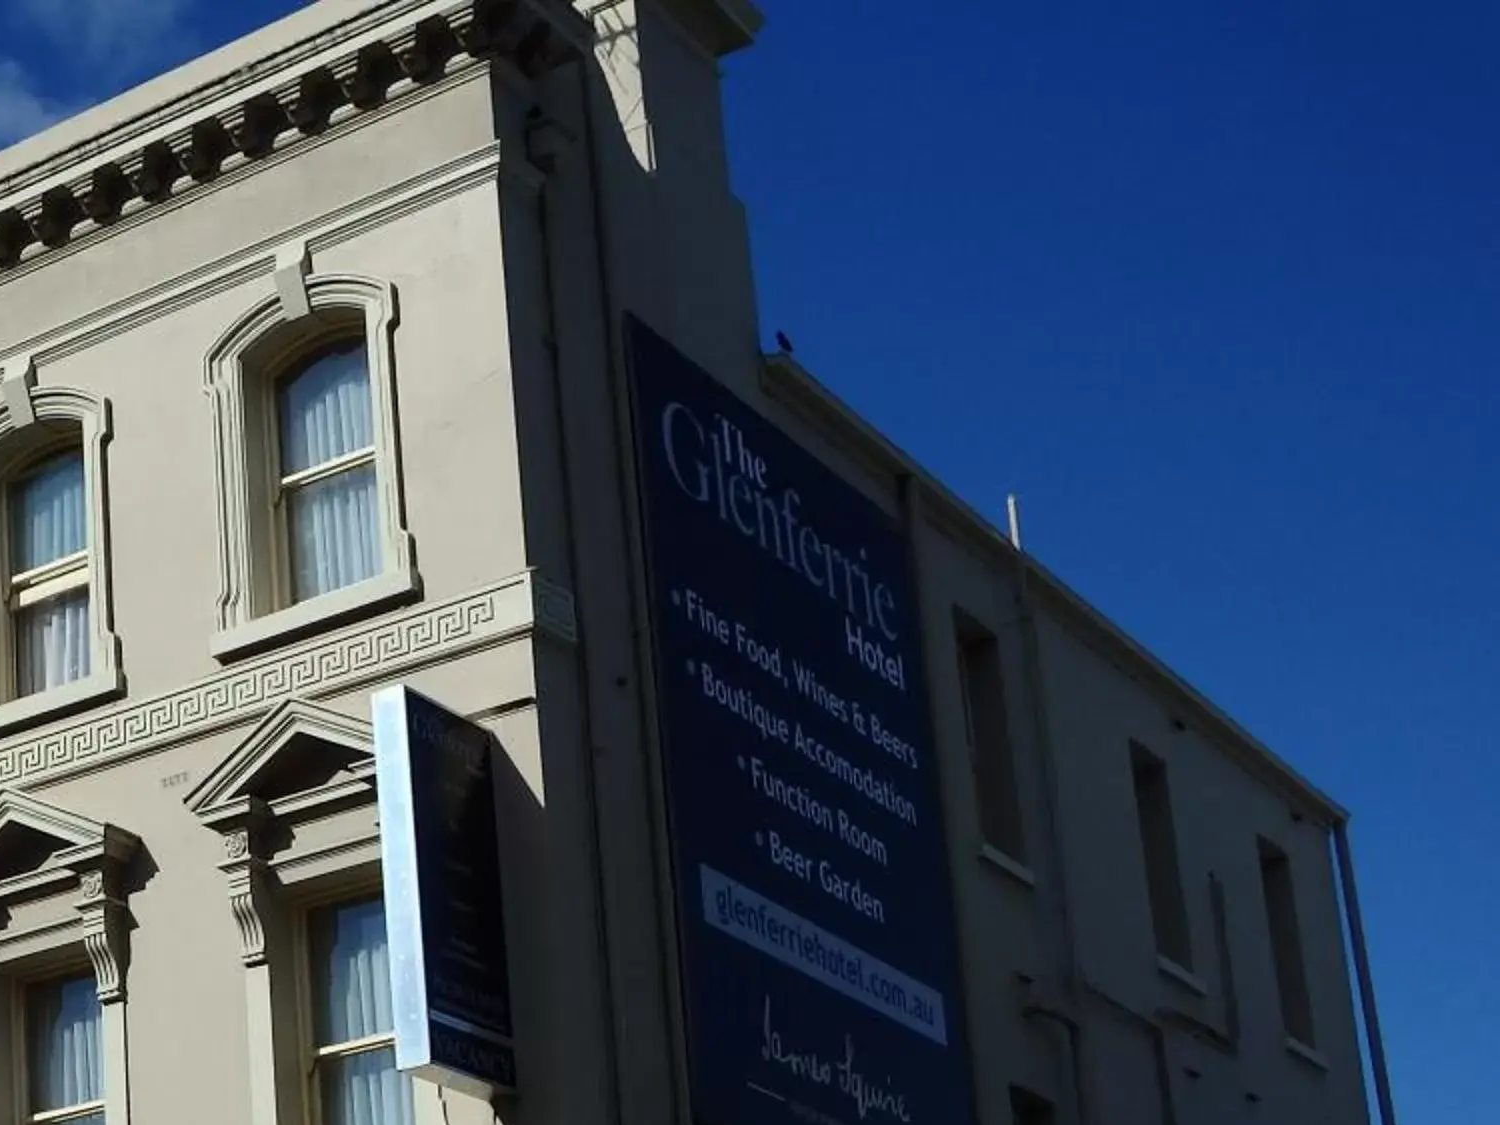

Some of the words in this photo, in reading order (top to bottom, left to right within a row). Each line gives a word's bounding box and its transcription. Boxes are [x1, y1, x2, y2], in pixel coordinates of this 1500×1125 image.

[714, 412, 767, 490] The
[662, 402, 898, 641] Glenferrie
[685, 588, 729, 645] Fine
[735, 622, 789, 690] Food,
[792, 658, 850, 723] Wines
[852, 702, 867, 736] &
[869, 713, 918, 769] Beers
[845, 614, 906, 691] Hotel
[700, 662, 789, 744] Boutique
[794, 720, 917, 826] Accomodation
[750, 756, 833, 834] Function
[838, 809, 888, 867] Room
[769, 830, 813, 883] Beer
[820, 860, 886, 925] Garden
[715, 885, 934, 1028] glenferriehotel.com.au
[761, 993, 831, 1087] James
[834, 1032, 911, 1122] Squire
